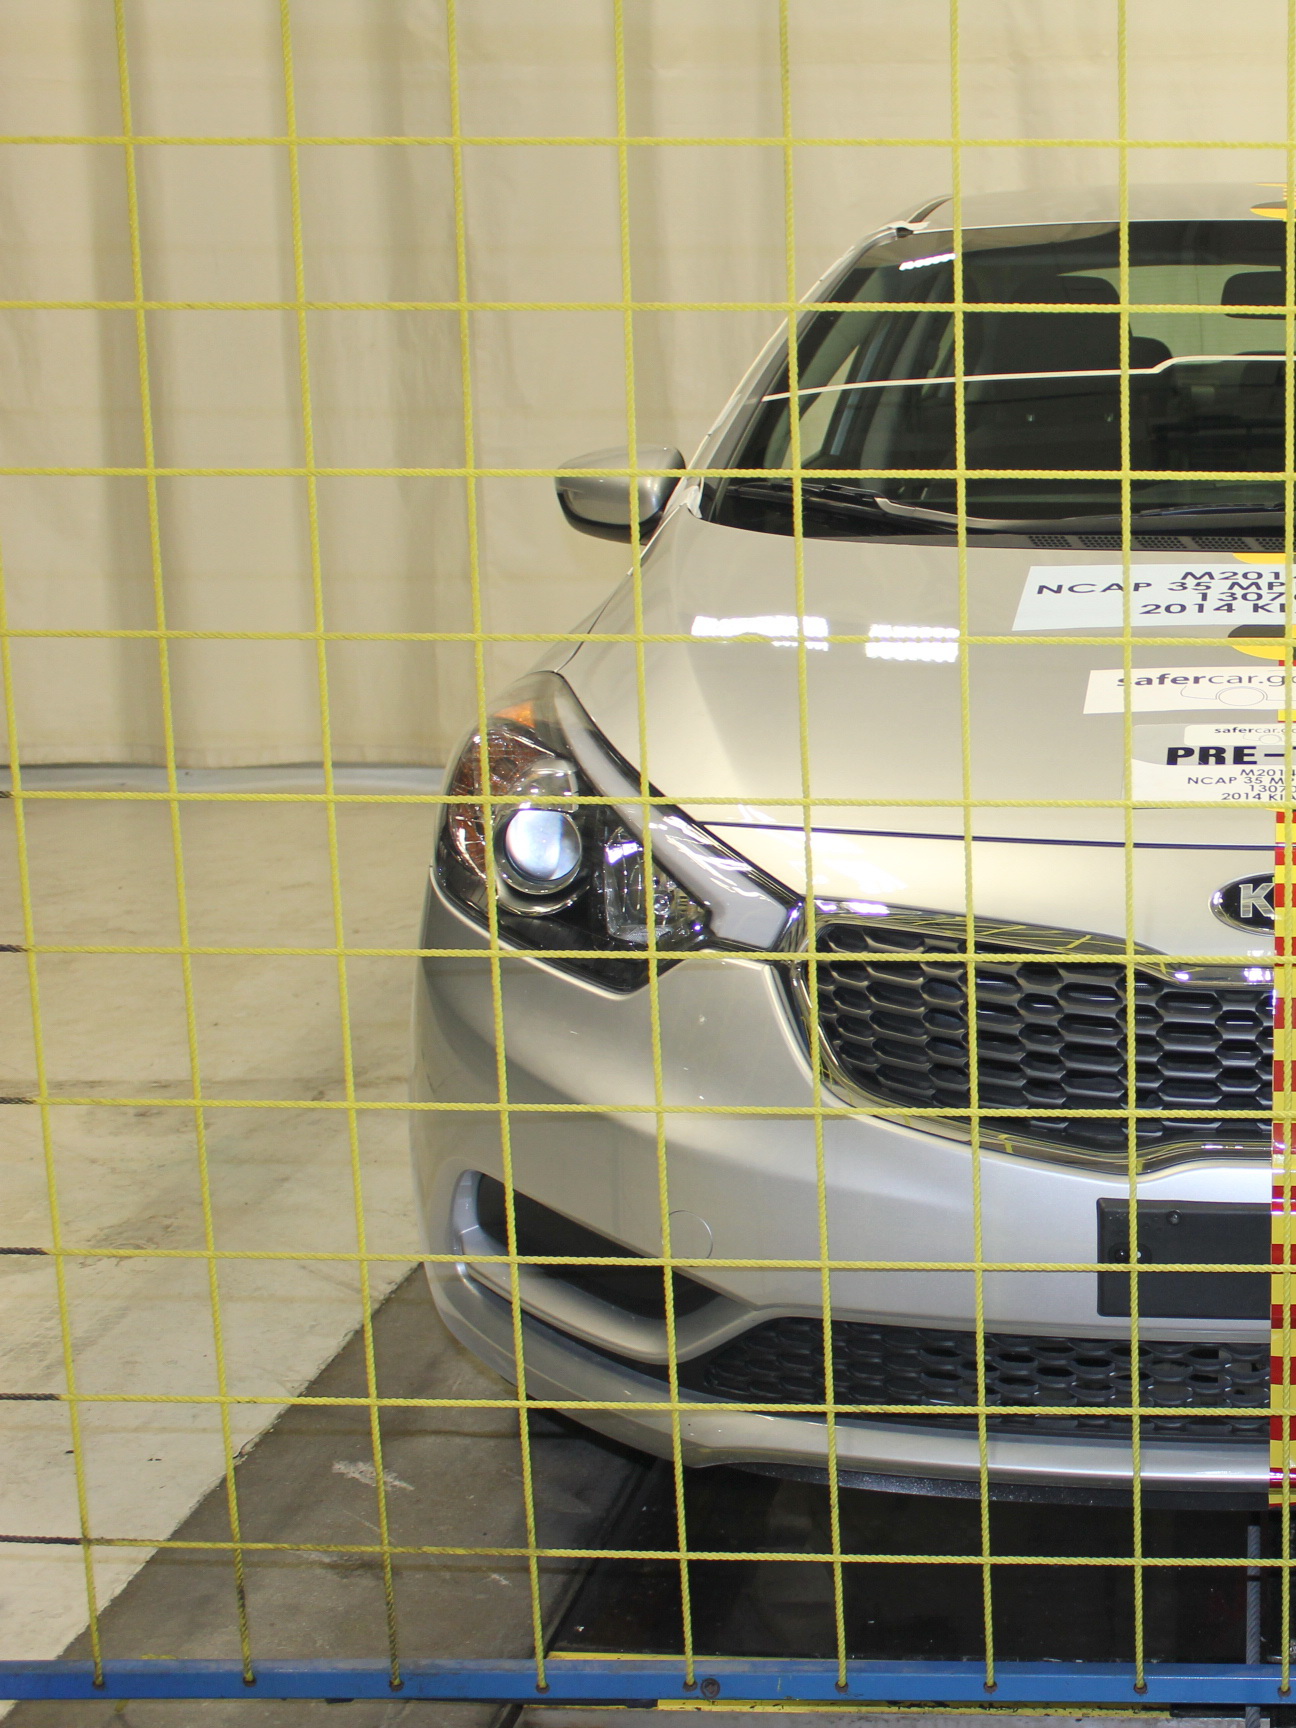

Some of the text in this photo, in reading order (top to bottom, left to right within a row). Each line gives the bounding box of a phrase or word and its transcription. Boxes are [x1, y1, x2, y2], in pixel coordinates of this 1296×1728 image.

[1037, 583, 1152, 594] NCAP
[1167, 582, 1212, 591] 35
[1139, 603, 1235, 614] 2014
[1187, 777, 1237, 785] NCAP
